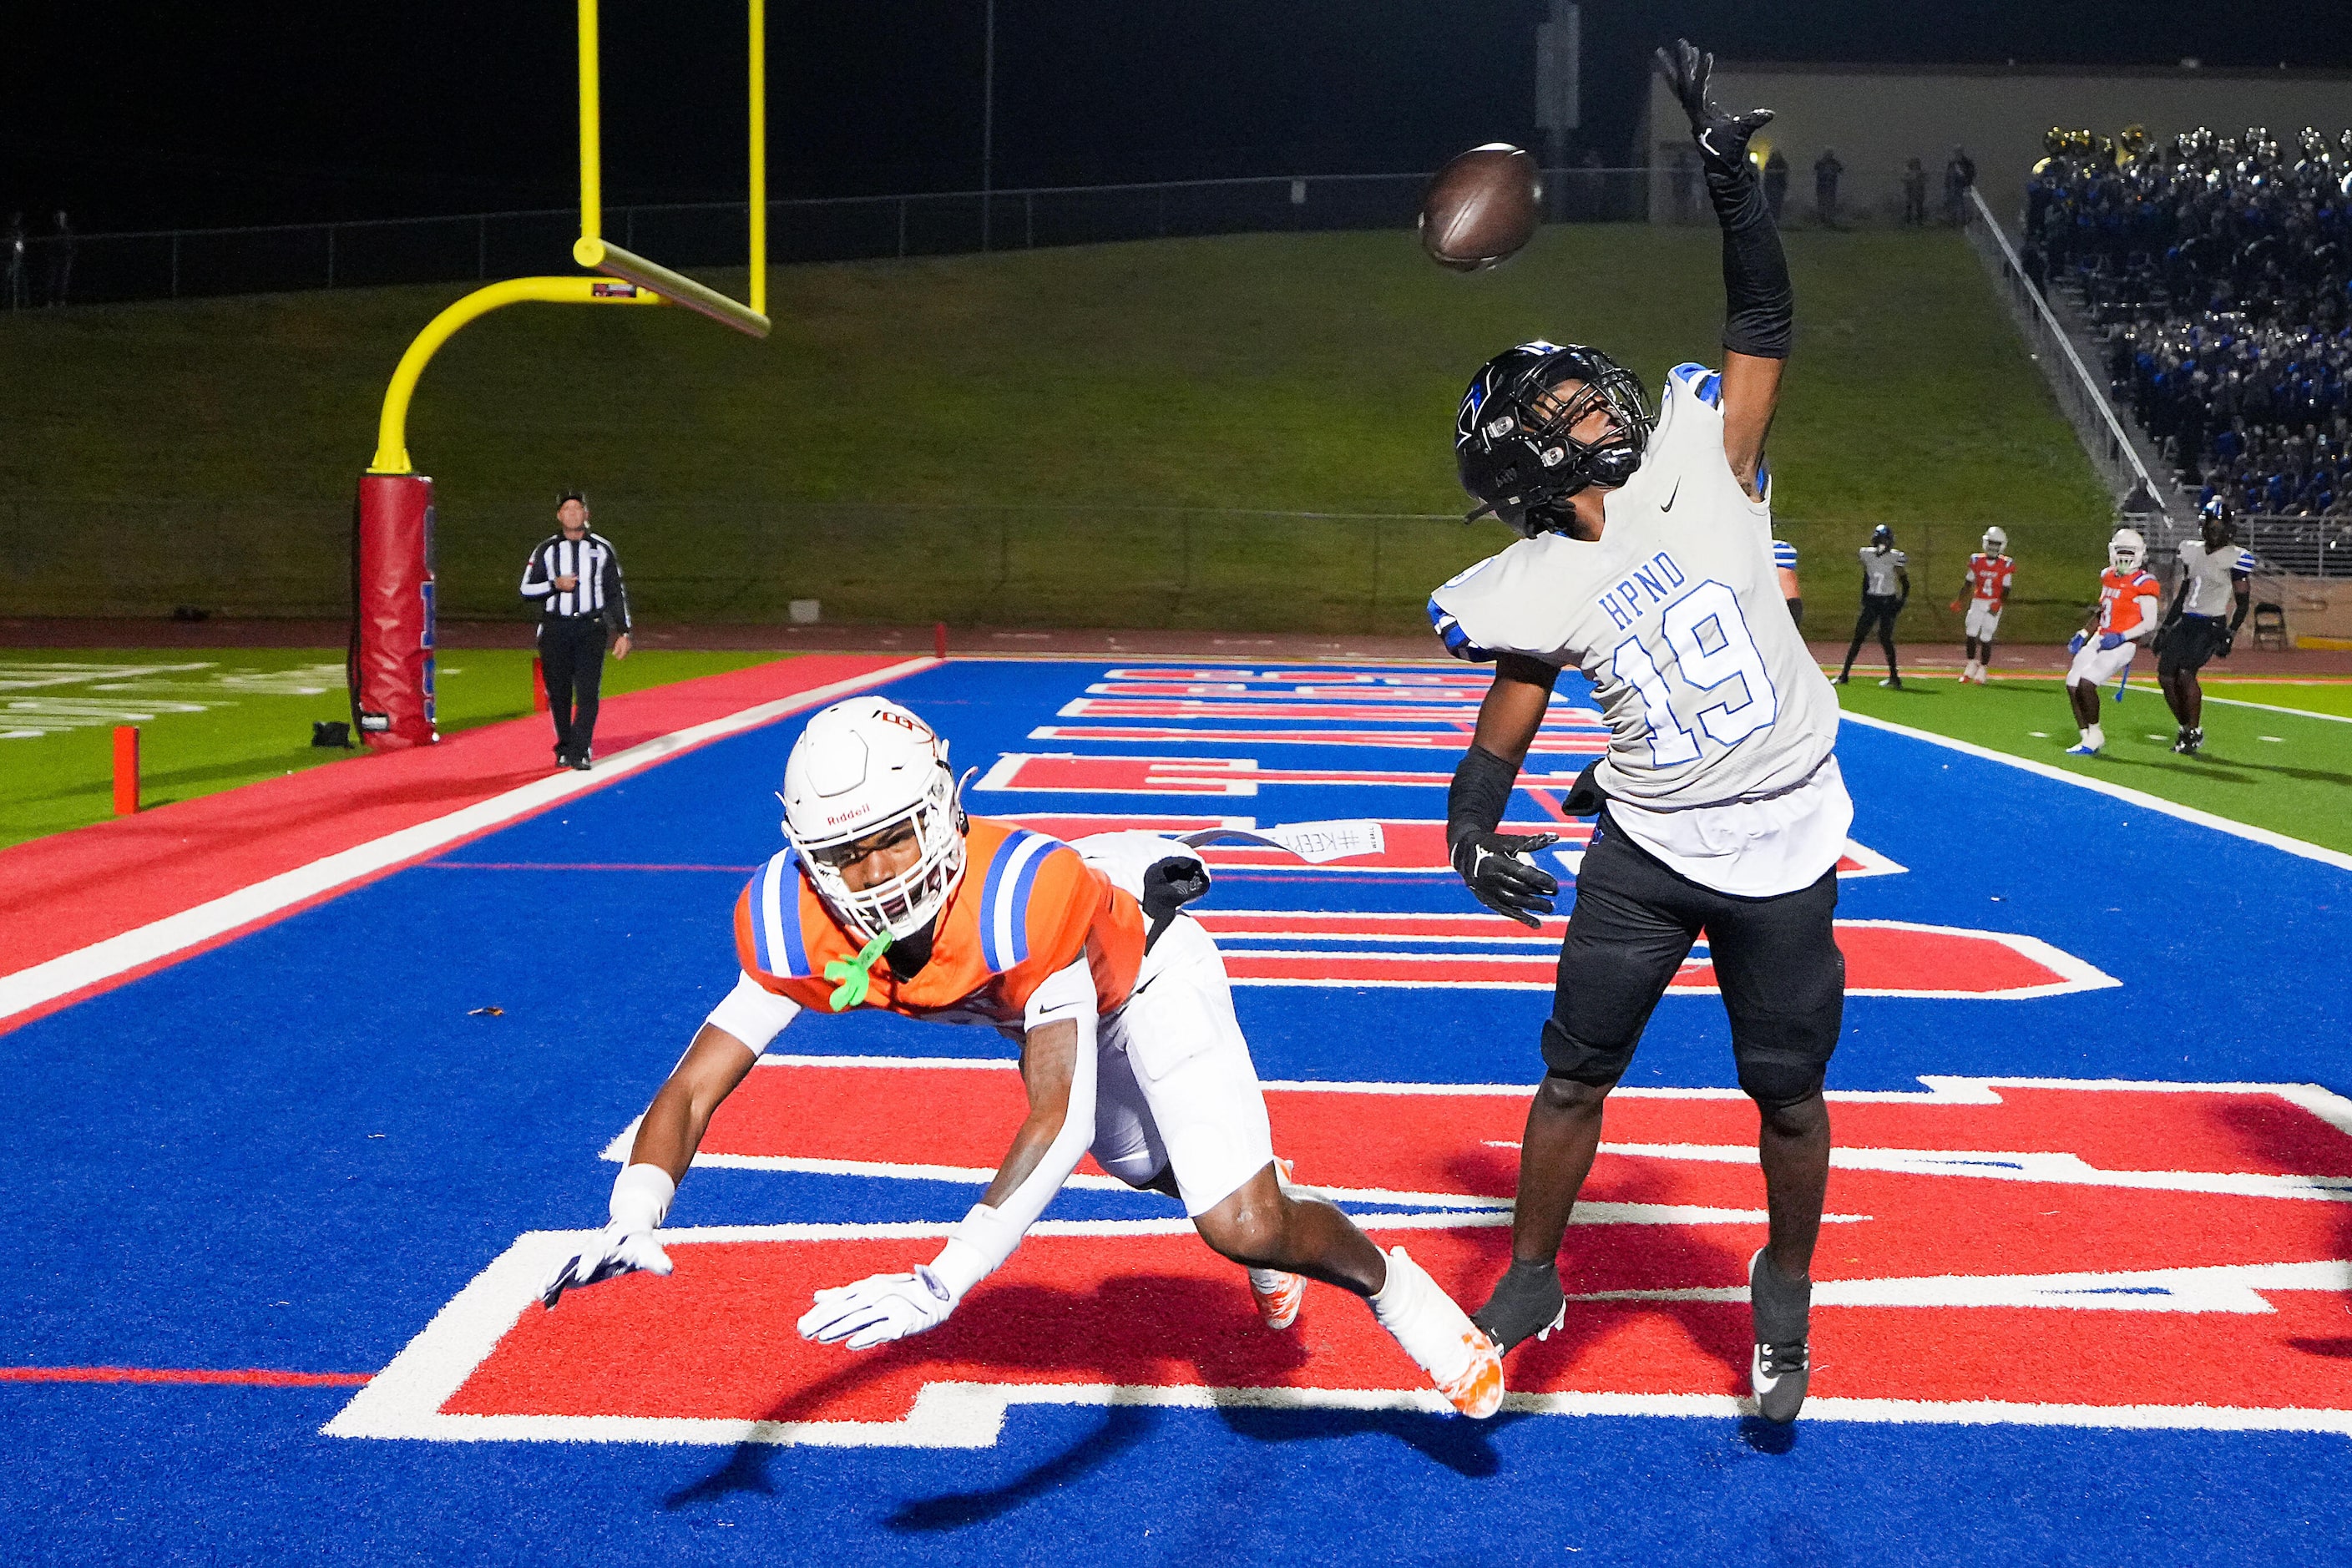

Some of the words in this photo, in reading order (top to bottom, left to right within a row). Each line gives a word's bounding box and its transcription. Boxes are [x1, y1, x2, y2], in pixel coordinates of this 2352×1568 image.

[1598, 551, 1685, 631] HPND
[1981, 578, 1994, 597] 4
[2099, 598, 2113, 629] 3
[1611, 578, 1778, 767] 19
[827, 803, 871, 827] Riddell
